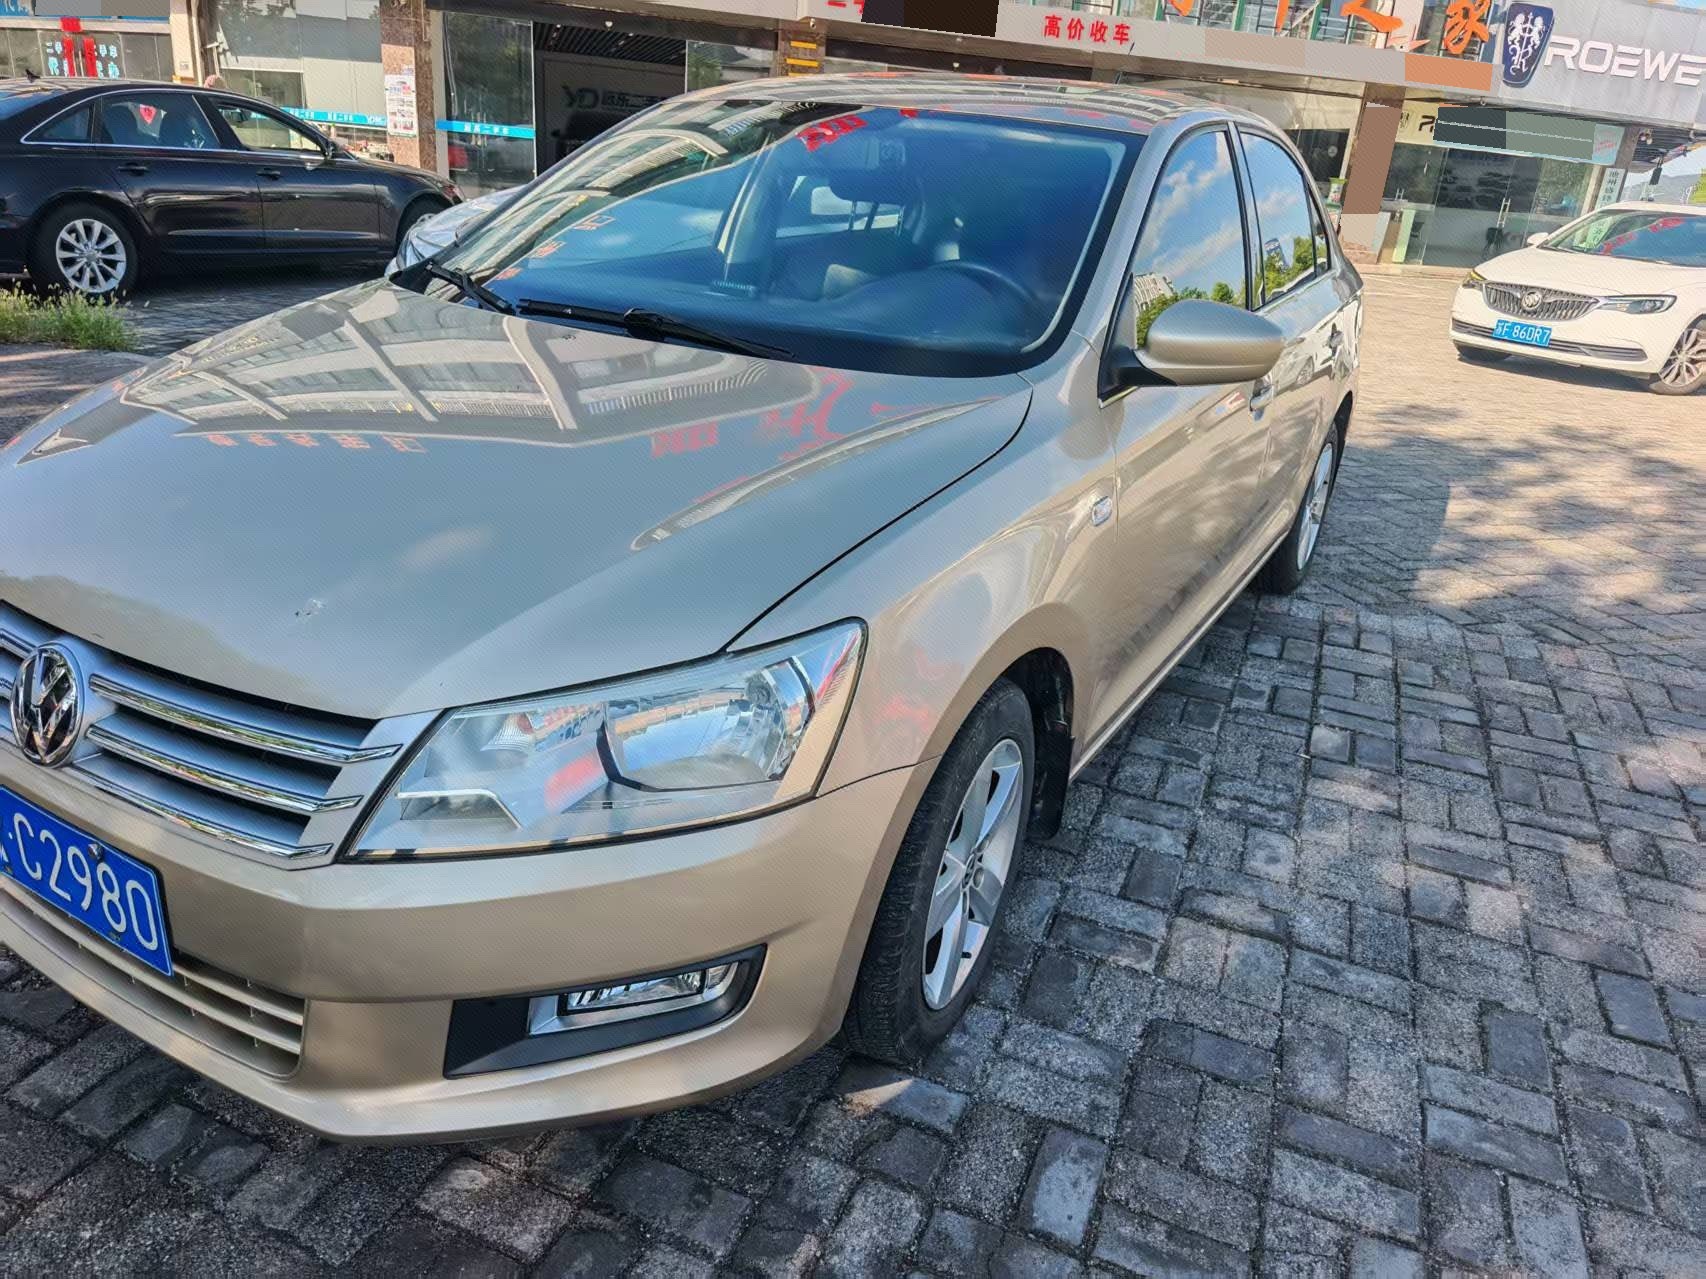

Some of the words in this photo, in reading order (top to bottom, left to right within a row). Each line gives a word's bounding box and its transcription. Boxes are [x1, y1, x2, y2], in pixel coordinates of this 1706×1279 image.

[1043, 14, 1131, 46] 高价收车
[1544, 34, 1706, 86] ROEWE
